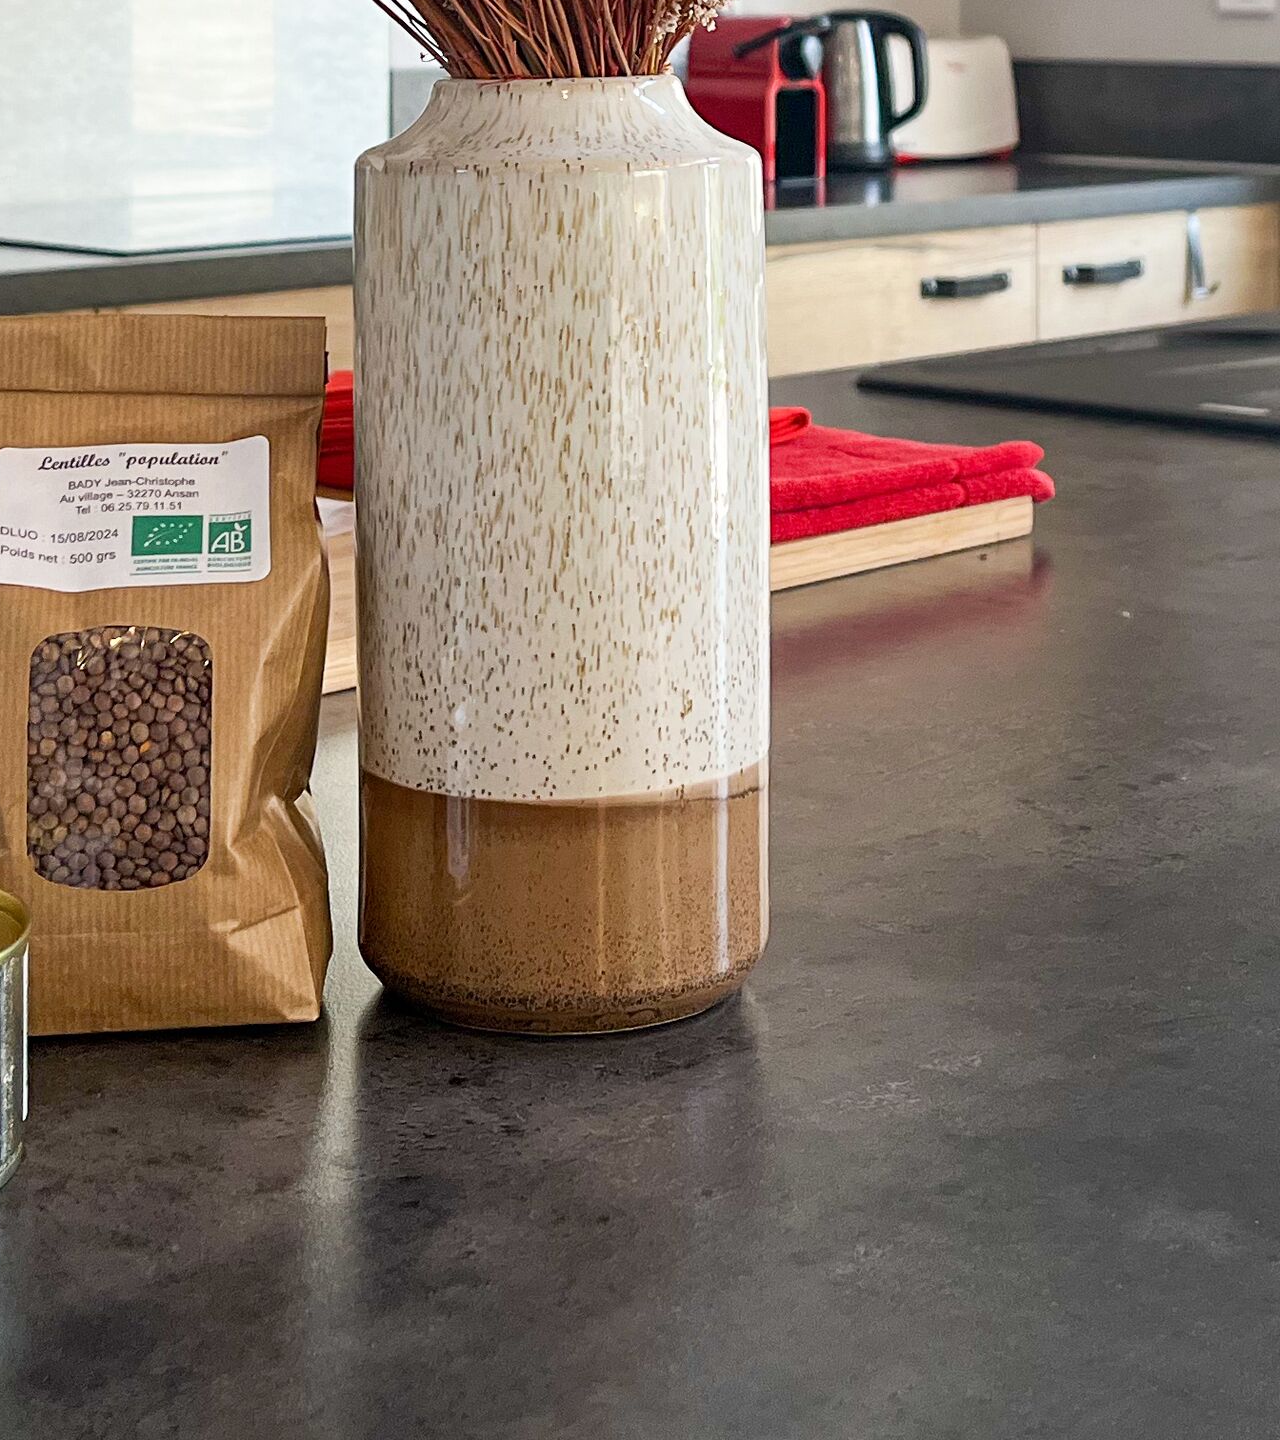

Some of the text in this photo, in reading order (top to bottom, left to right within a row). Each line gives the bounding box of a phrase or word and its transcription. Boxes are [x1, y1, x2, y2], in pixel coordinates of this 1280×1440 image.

[38, 453, 111, 471] Lentilles
[68, 476, 196, 491] BADY Jean-Christophe
[59, 495, 75, 504] Au
[78, 491, 114, 503] village
[127, 490, 162, 499] 32270
[164, 489, 200, 498] Ansan
[75, 505, 92, 515] Tel
[0, 526, 119, 544] DLUO 15/08/2024
[210, 530, 246, 553] AB
[0, 545, 35, 560] Poids
[38, 552, 58, 564] net
[69, 551, 94, 564] 500
[96, 551, 117, 564] grs
